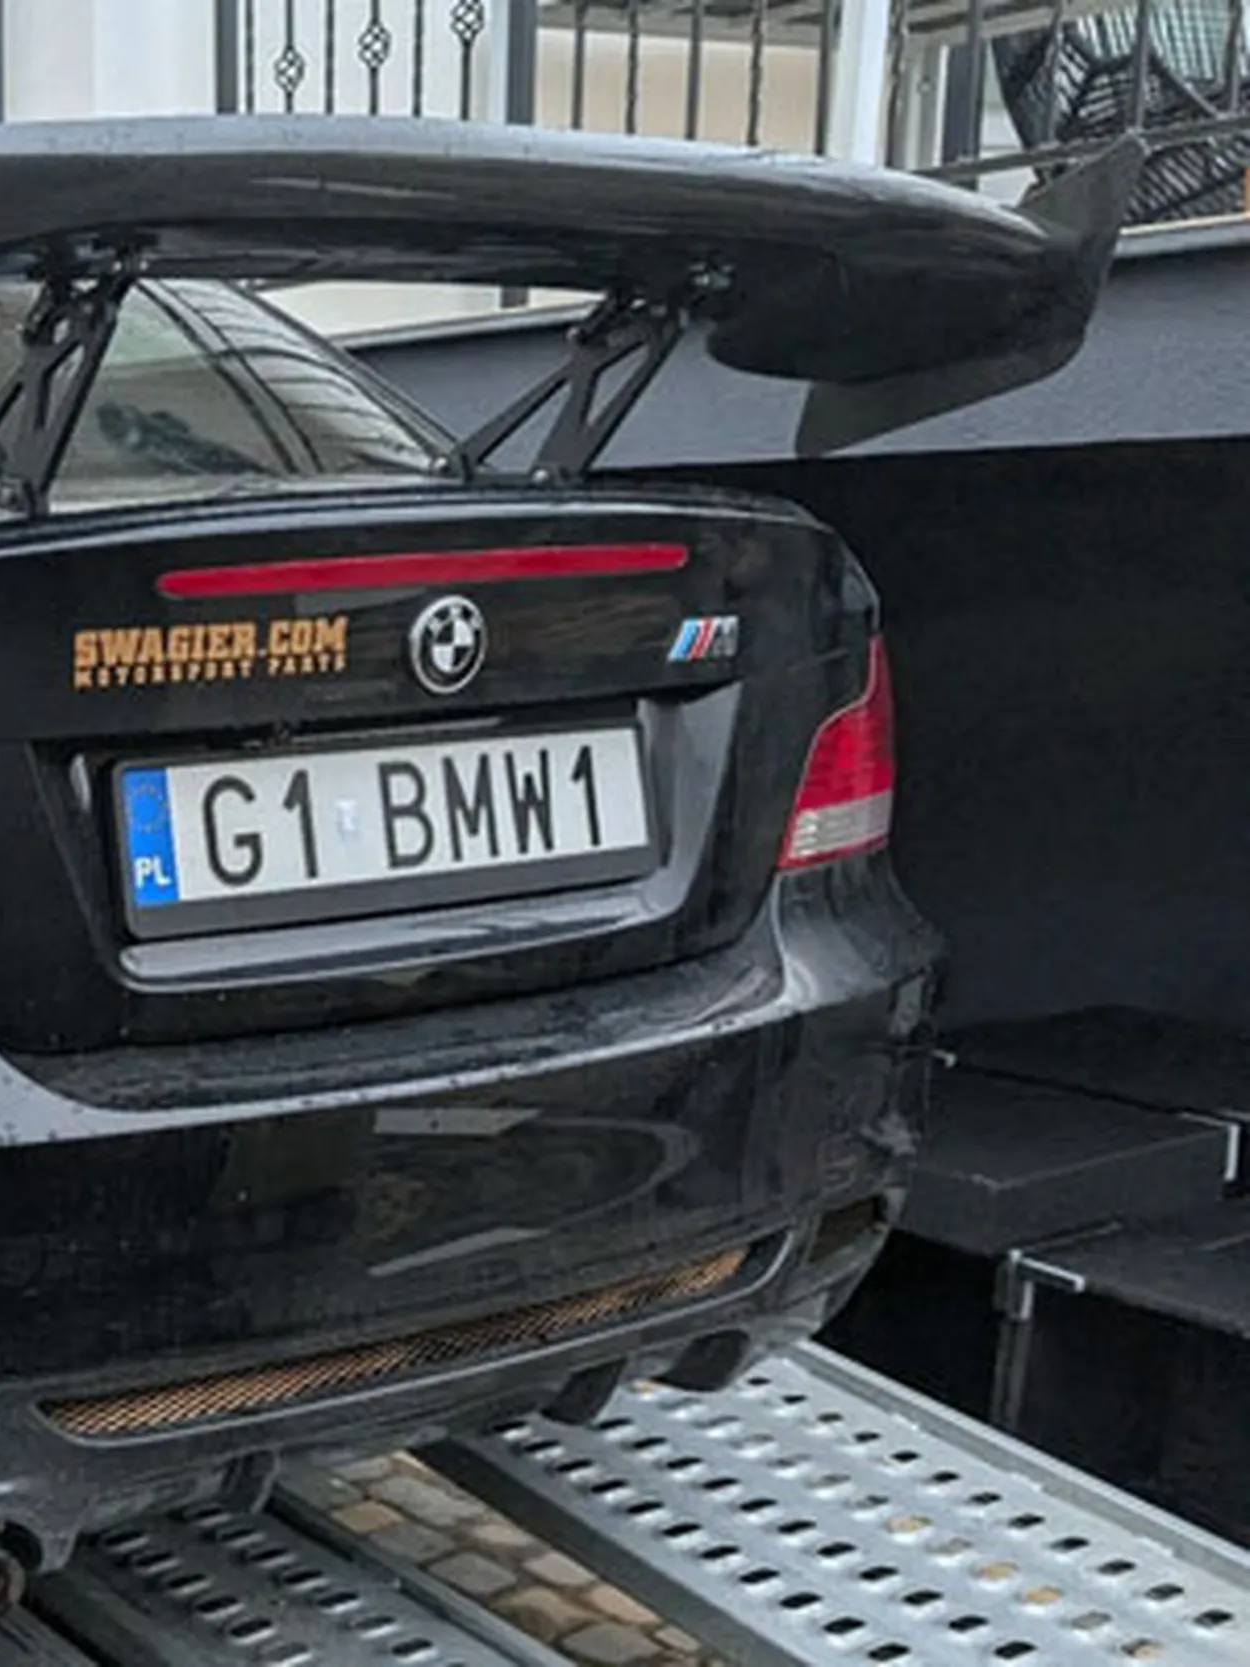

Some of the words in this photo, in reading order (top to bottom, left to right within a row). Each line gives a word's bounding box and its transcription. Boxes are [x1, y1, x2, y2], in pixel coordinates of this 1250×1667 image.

[74, 615, 348, 668] SWAGIER.COM
[203, 769, 318, 887] G1
[377, 744, 601, 869] BMW1
[134, 856, 172, 888] PL
